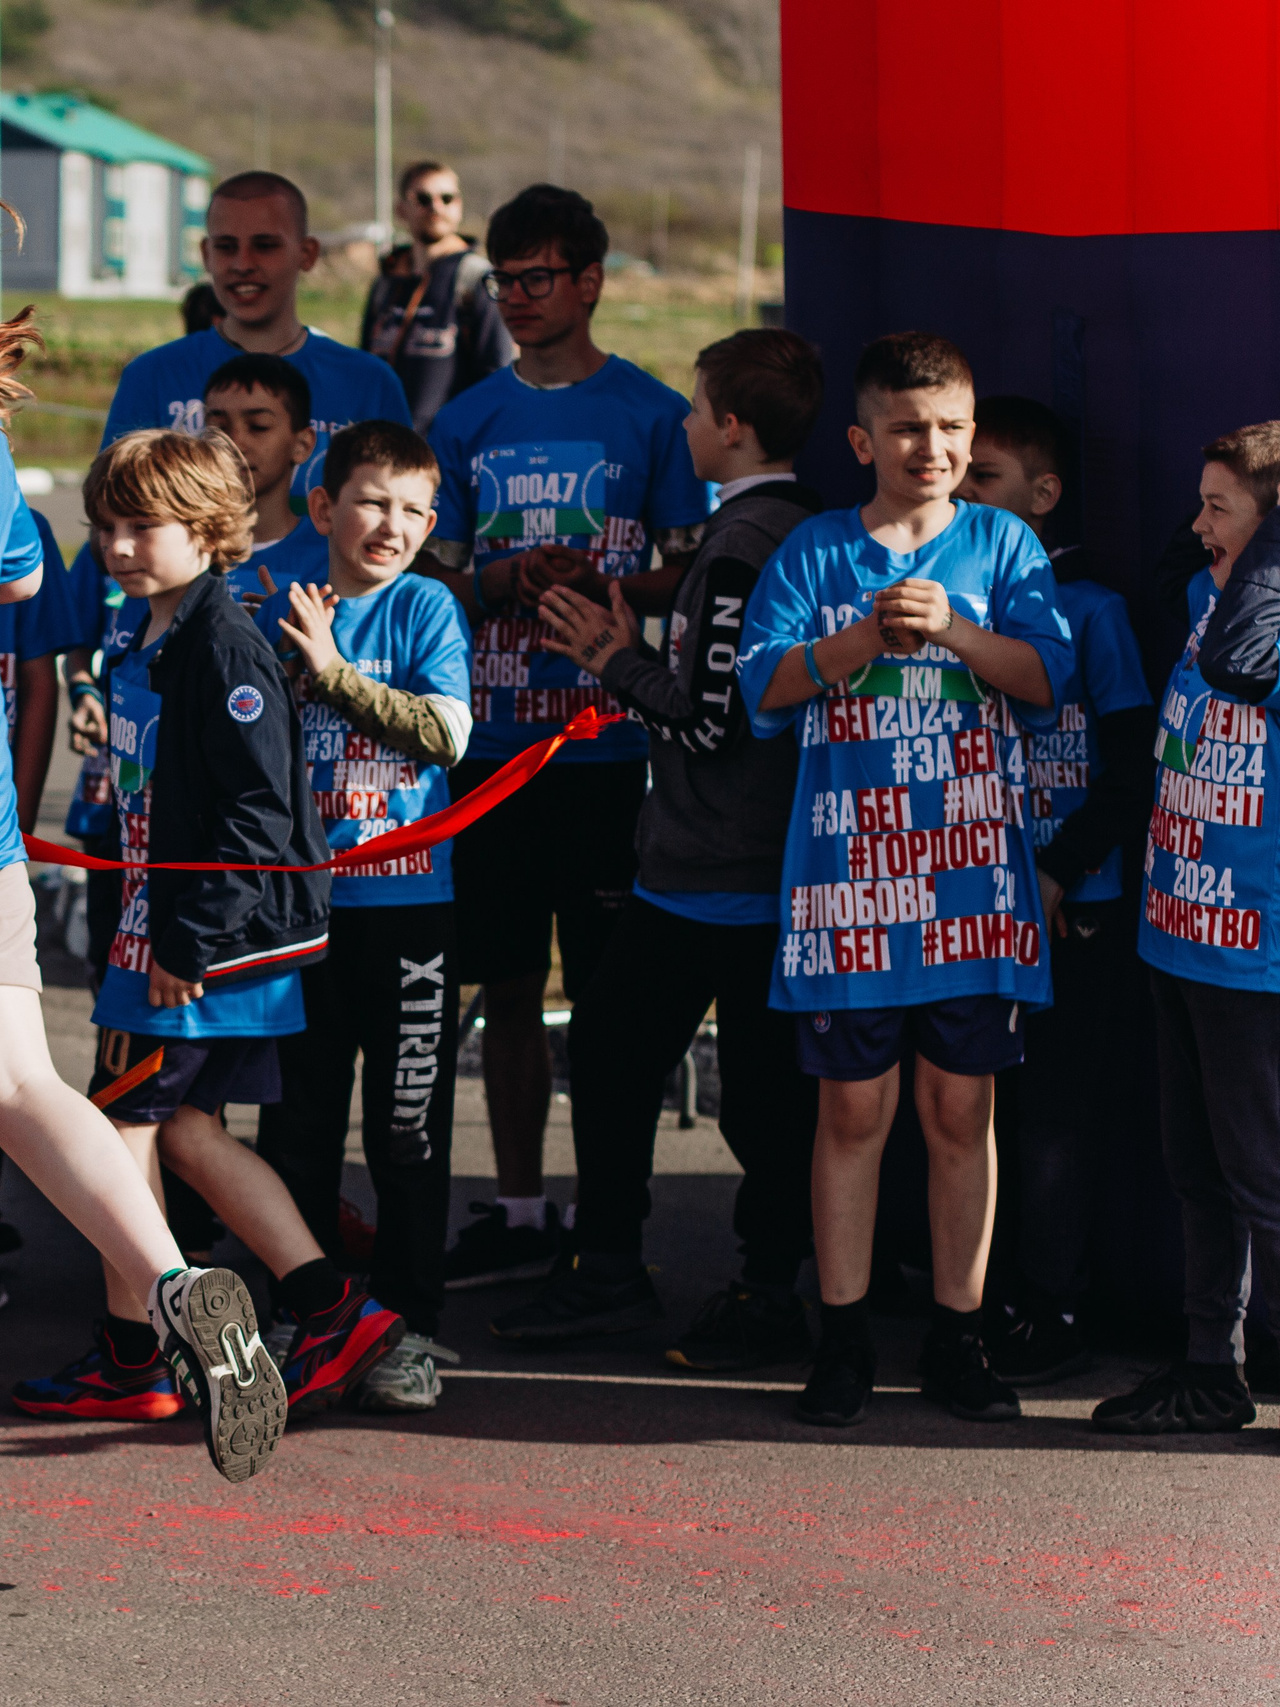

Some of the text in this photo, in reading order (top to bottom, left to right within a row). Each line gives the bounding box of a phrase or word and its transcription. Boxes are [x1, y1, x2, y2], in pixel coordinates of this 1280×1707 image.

[506, 472, 578, 505] 10047
[522, 508, 557, 536] 1KM
[900, 666, 942, 699] 1KM
[812, 786, 912, 837] #ЗАБЕГ
[1159, 767, 1264, 827] #МОМЕНТ
[791, 876, 936, 931] #ЛЮБОВЬ
[1173, 857, 1235, 907] 2024
[783, 927, 891, 977] #ЗАБЕГ
